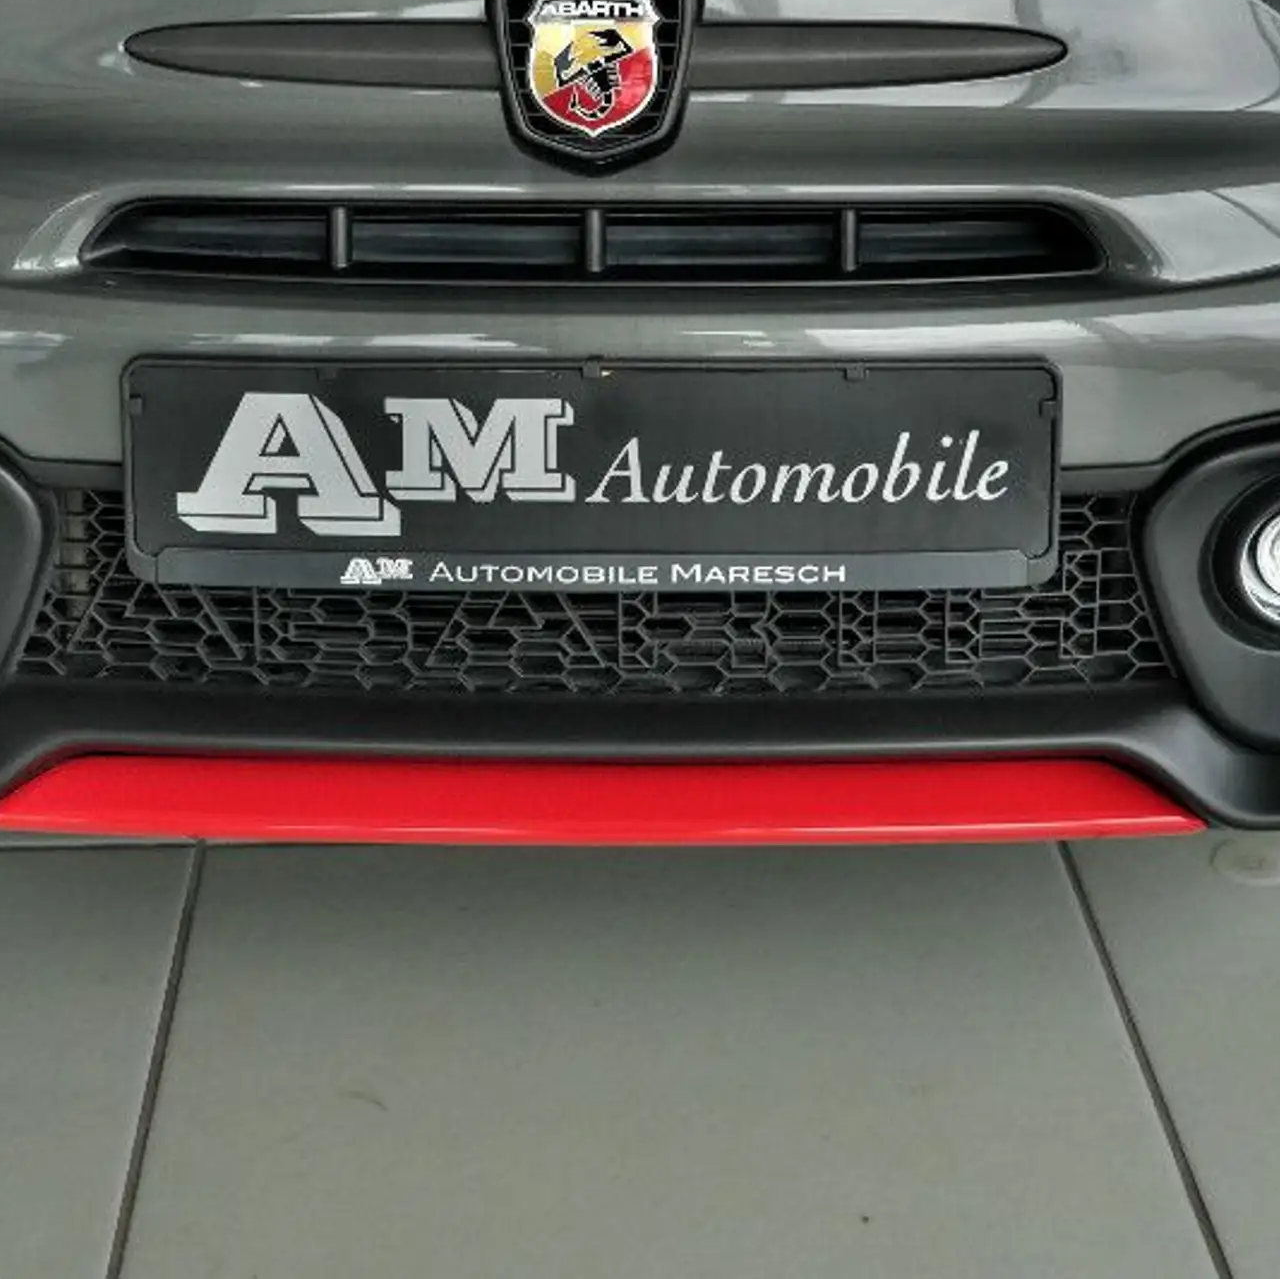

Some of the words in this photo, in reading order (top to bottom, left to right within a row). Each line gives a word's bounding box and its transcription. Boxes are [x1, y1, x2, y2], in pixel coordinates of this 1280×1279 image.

[540, 0, 644, 17] ABARTH
[176, 391, 577, 536] AM
[585, 429, 1009, 504] Automobile
[340, 557, 414, 585] AM
[428, 561, 659, 584] AUTOMOBILE
[670, 563, 847, 584] MARESCH
